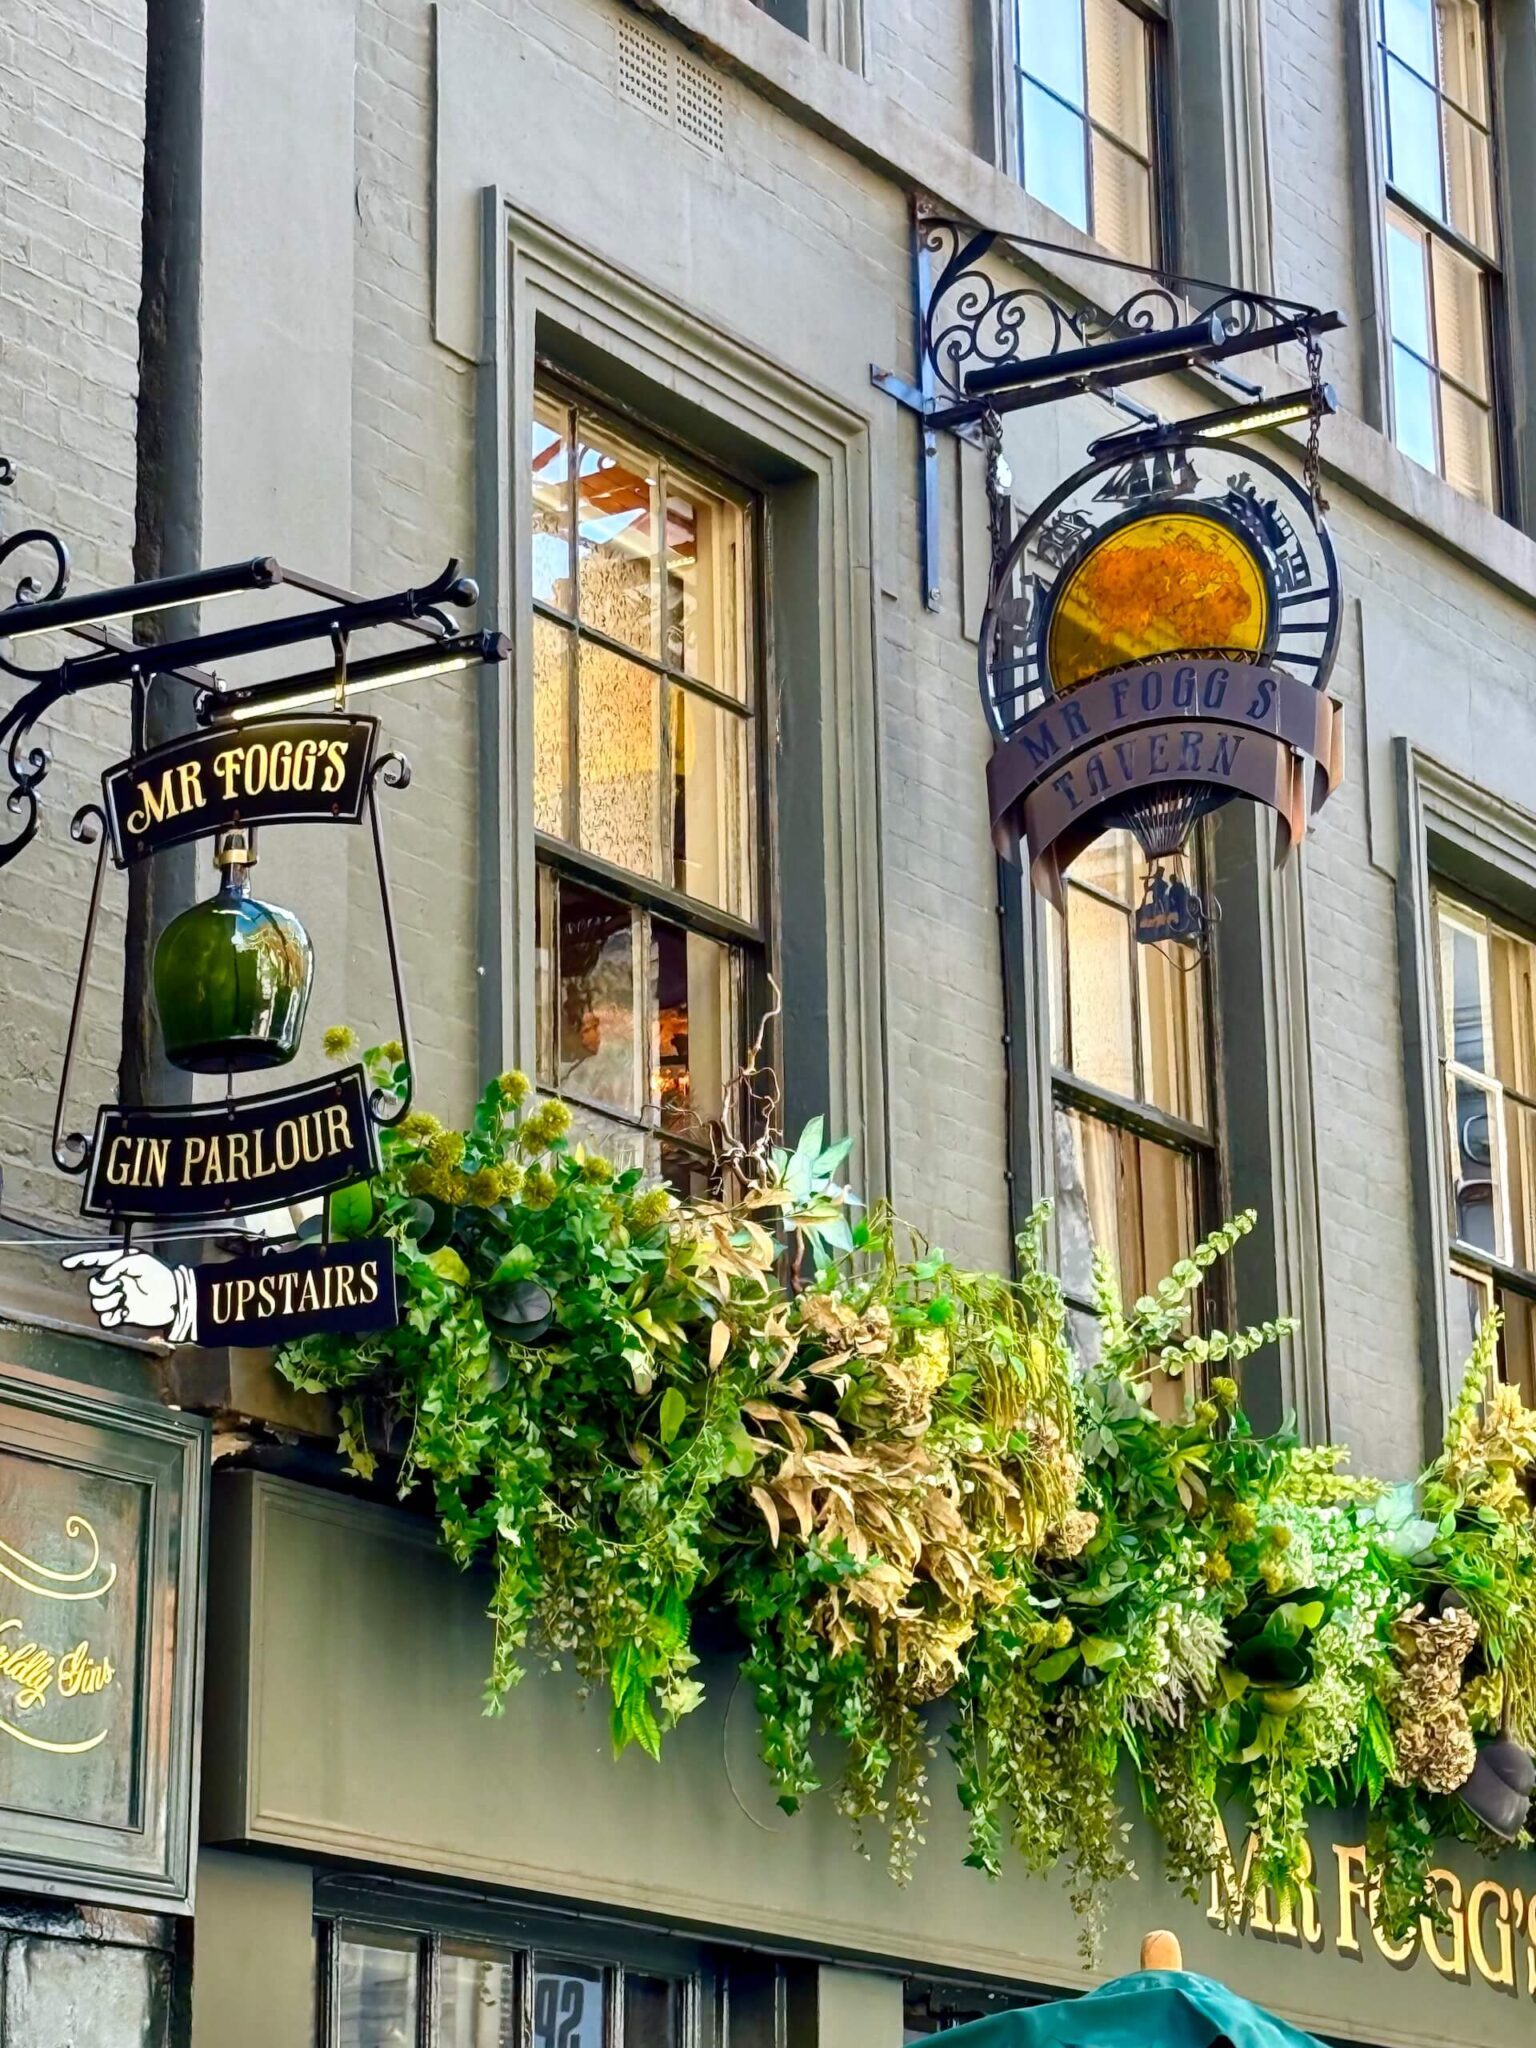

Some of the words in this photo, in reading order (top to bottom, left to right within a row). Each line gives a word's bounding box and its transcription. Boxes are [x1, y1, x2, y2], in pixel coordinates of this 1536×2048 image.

[1018, 700, 1091, 770] MR
[1053, 730, 1245, 811] TAVERN
[127, 761, 207, 834] MR
[213, 740, 349, 800] FOGG'S
[106, 1135, 172, 1188] GIN
[180, 1104, 354, 1187] PARLOUR
[211, 1261, 378, 1324] UPSTAIRS
[58, 1640, 115, 1697] Gins
